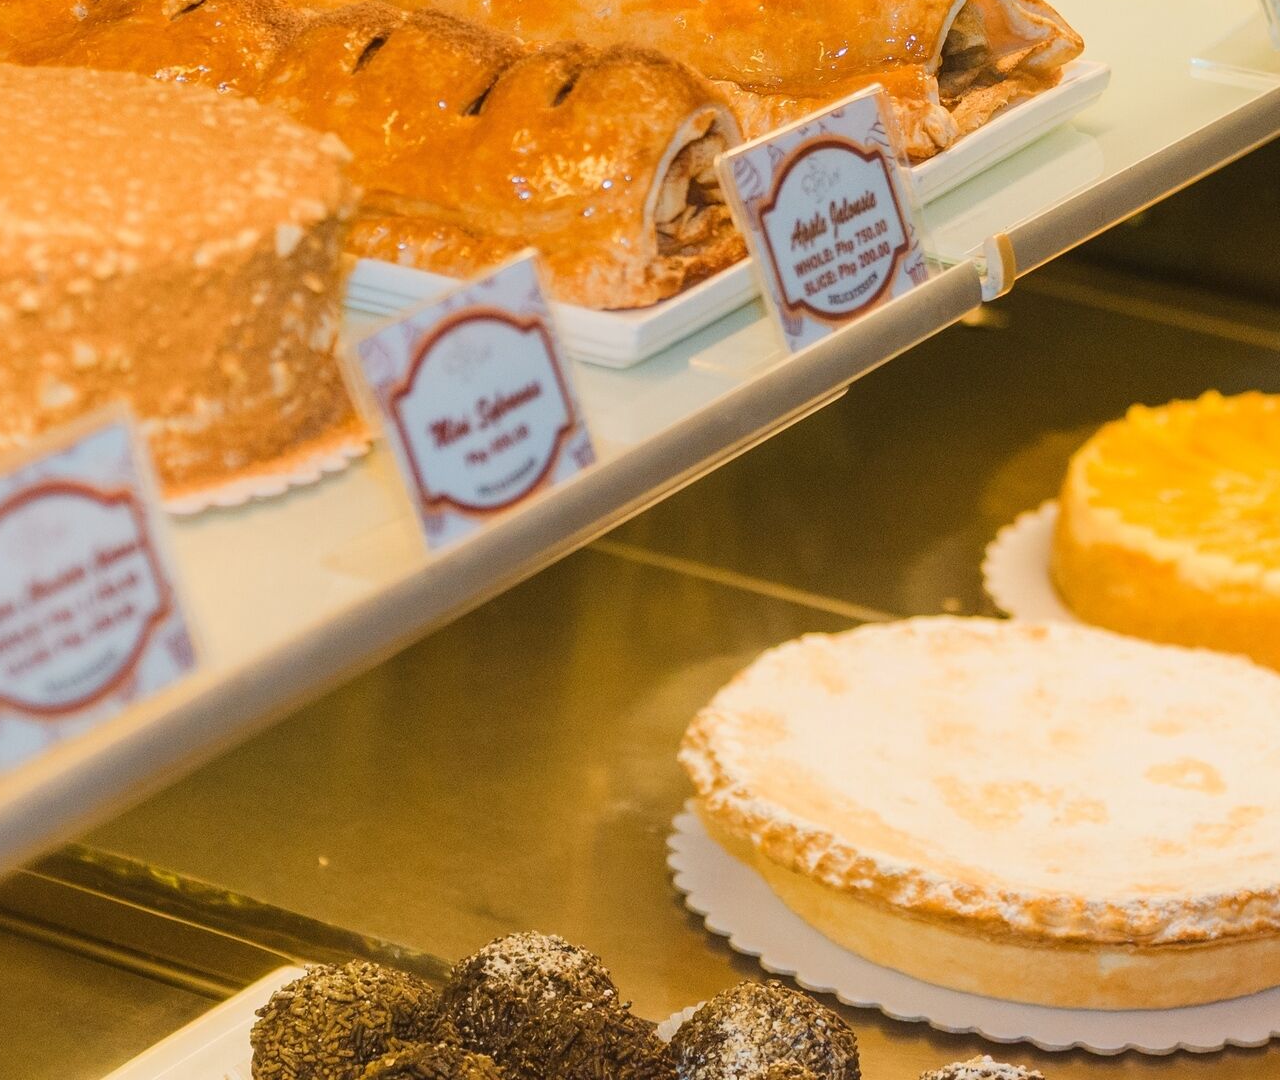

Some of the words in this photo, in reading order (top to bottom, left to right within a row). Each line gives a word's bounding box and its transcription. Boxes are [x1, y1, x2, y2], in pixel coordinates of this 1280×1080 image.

[790, 211, 827, 250] Apple
[794, 248, 834, 277] WHOLE:
[835, 240, 854, 256] Php
[854, 219, 888, 245] 750.00
[803, 270, 837, 296] SLICE:
[838, 262, 857, 279] Php
[858, 241, 890, 268] 200.00
